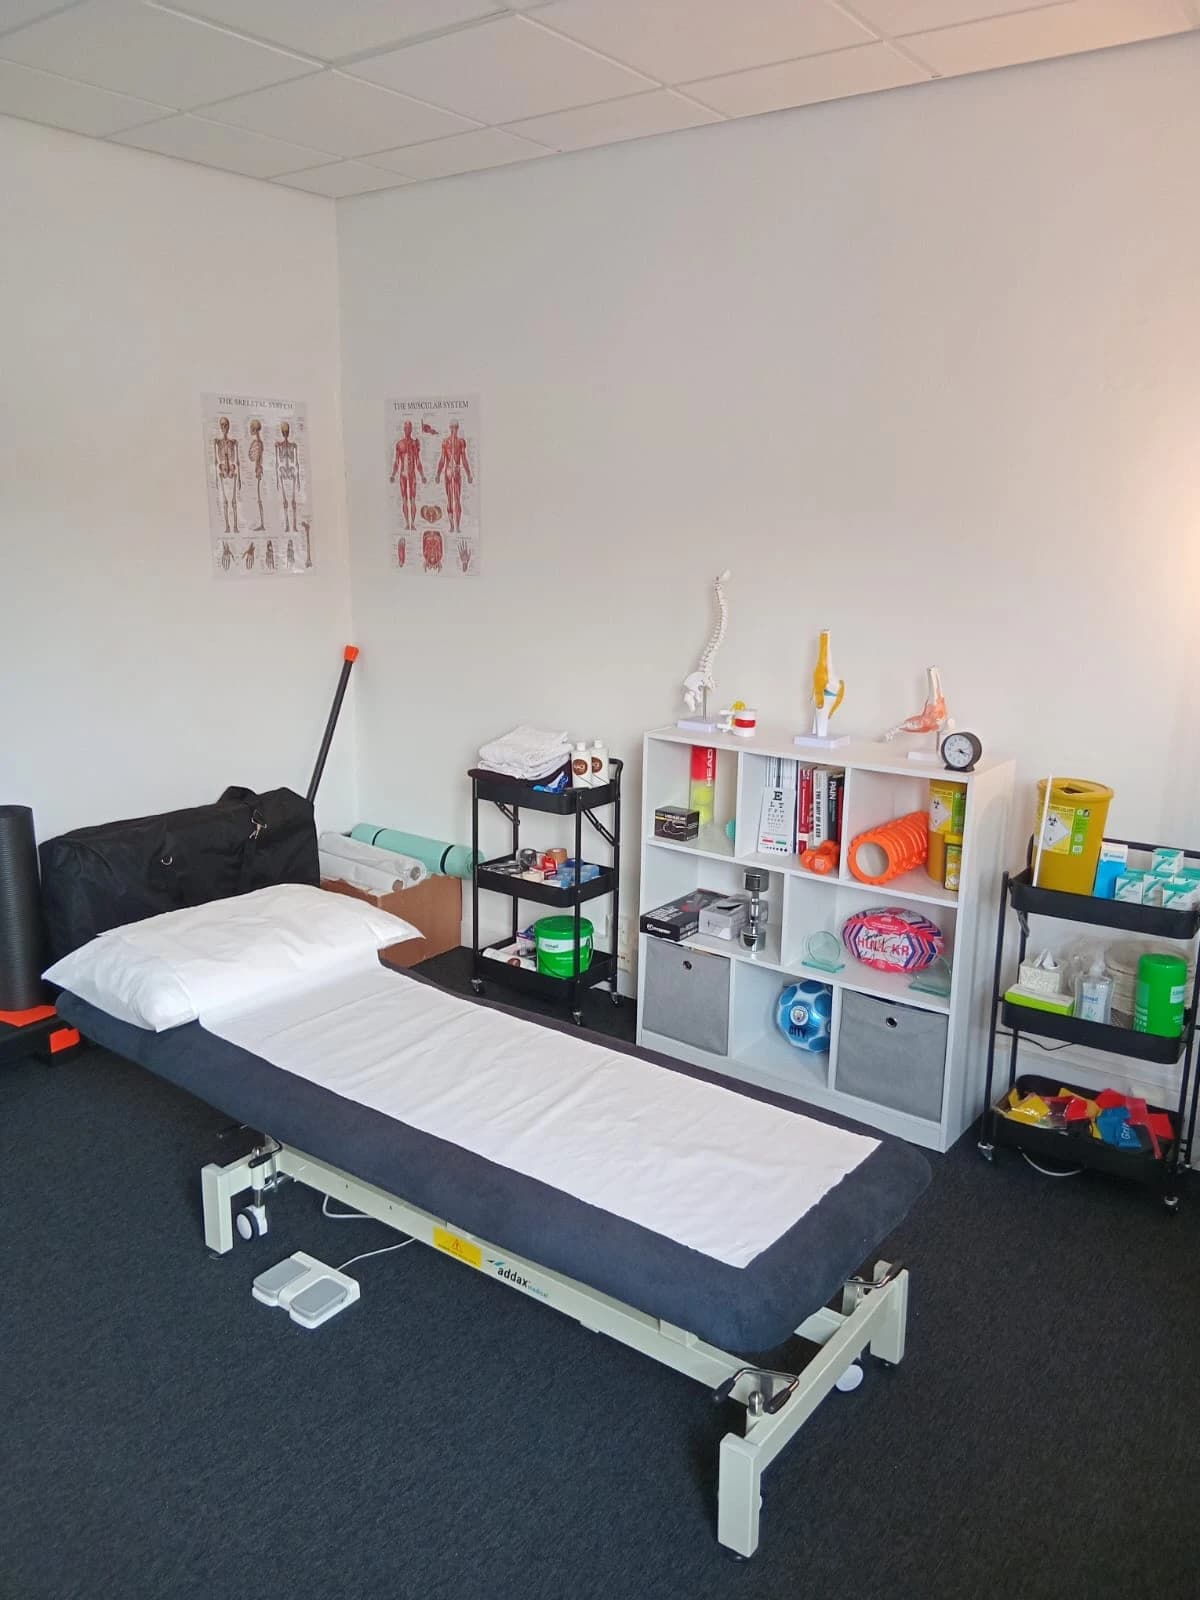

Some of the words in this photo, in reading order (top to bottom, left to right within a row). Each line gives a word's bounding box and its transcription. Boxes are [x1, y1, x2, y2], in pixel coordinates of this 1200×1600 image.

[218, 397, 233, 405] THE
[392, 401, 406, 411] THE
[407, 400, 442, 410] MUSCULAR
[443, 400, 469, 409] SYSTEM
[706, 748, 714, 787] HEAD
[773, 791, 783, 801] E
[828, 781, 837, 800] PAIN
[857, 936, 887, 953] HULL
[891, 943, 910, 957] KR
[497, 1267, 529, 1288] addax
